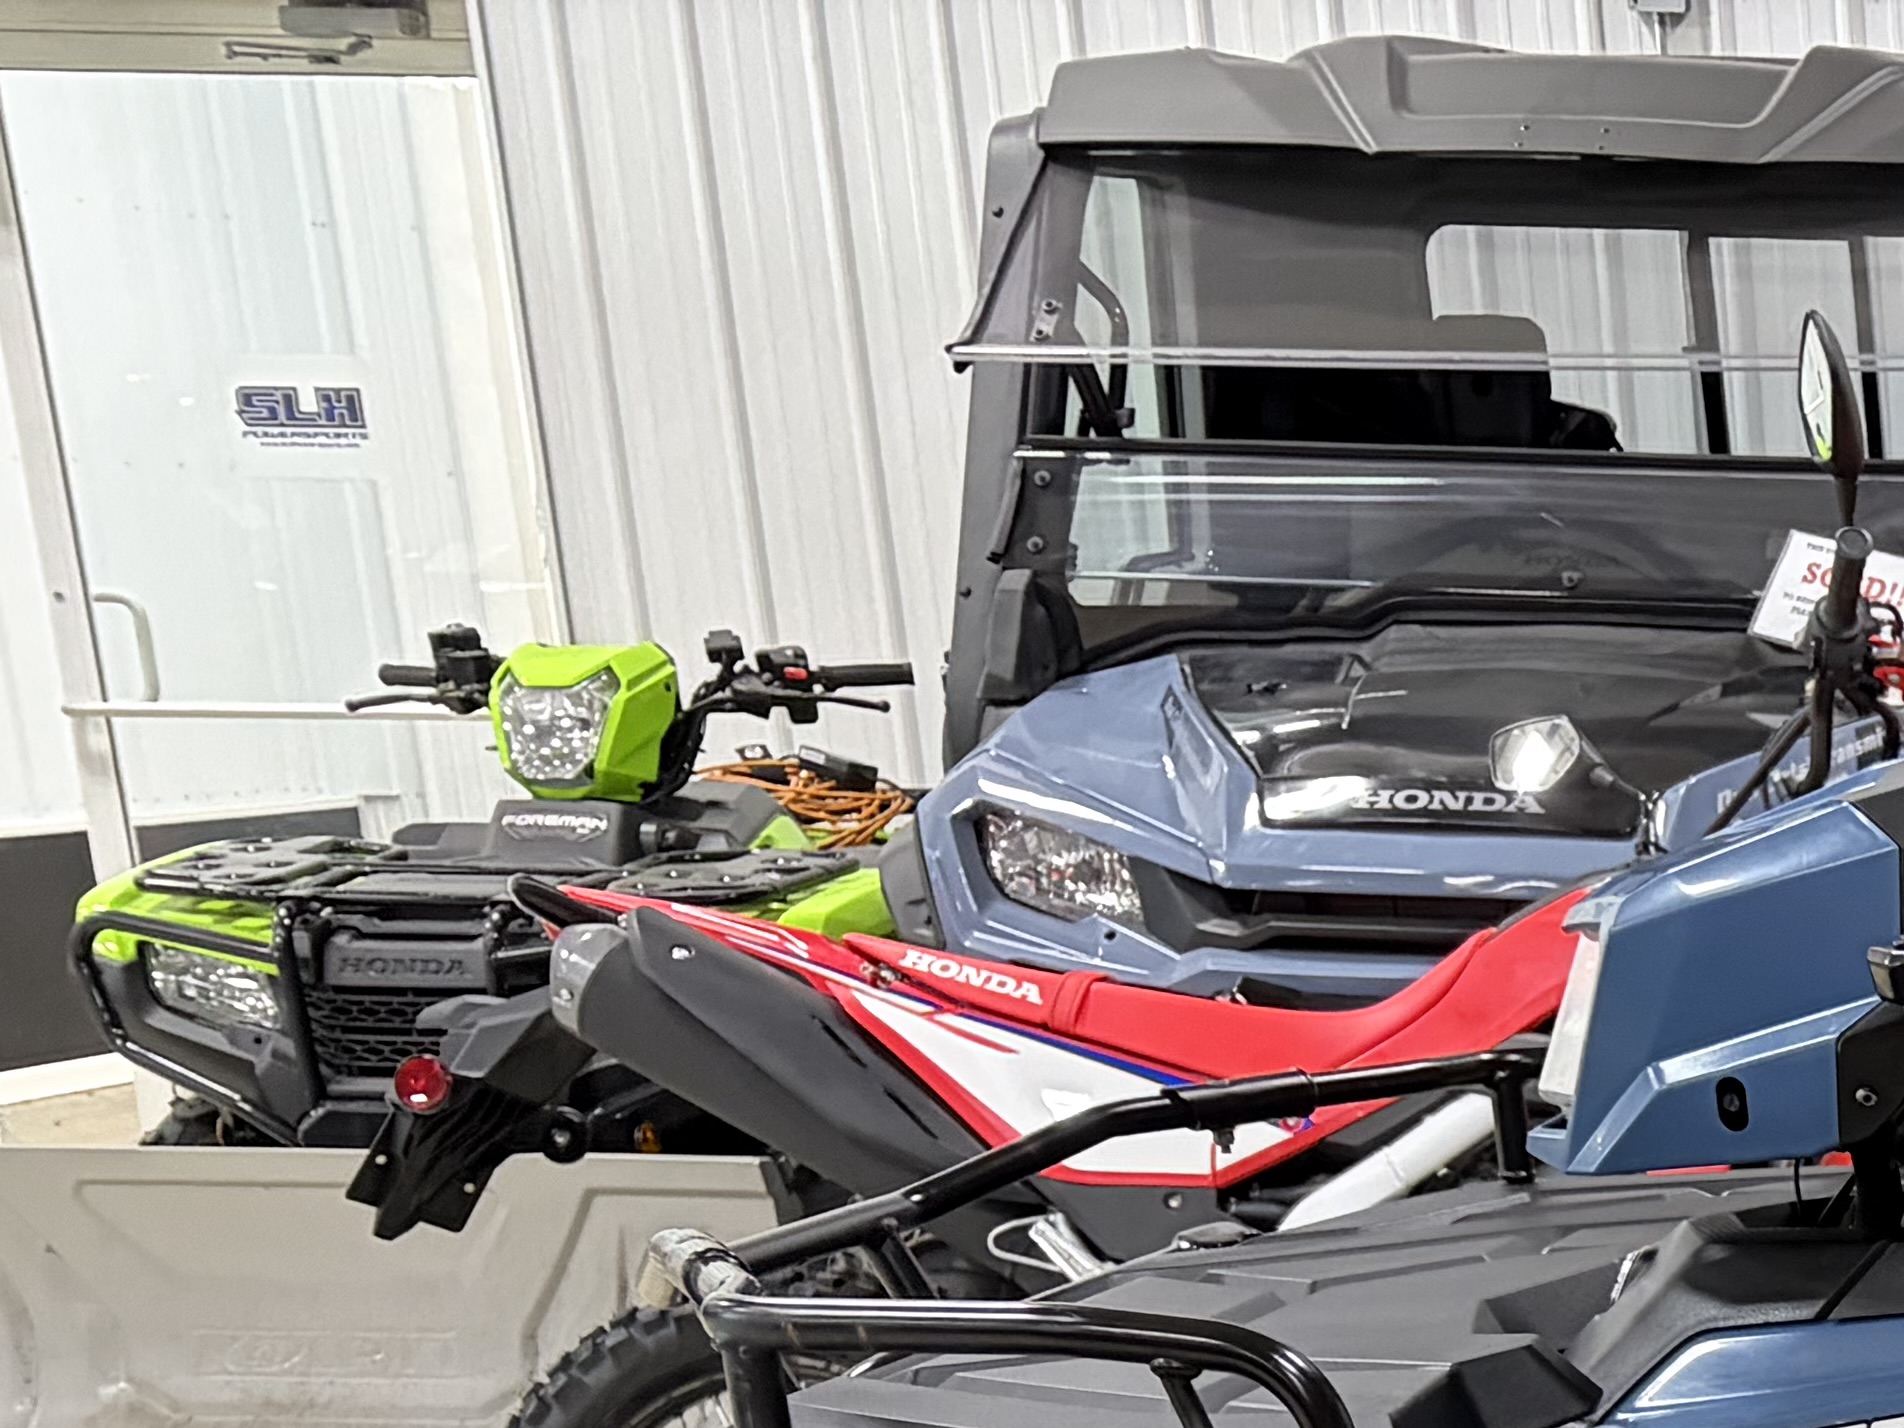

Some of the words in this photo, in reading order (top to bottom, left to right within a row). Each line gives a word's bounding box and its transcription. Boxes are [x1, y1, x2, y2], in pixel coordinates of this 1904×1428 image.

[235, 386, 367, 429] SLH
[1352, 789, 1546, 814] HONDA
[338, 957, 467, 976] HONDA
[899, 949, 1044, 1006] HONDA
